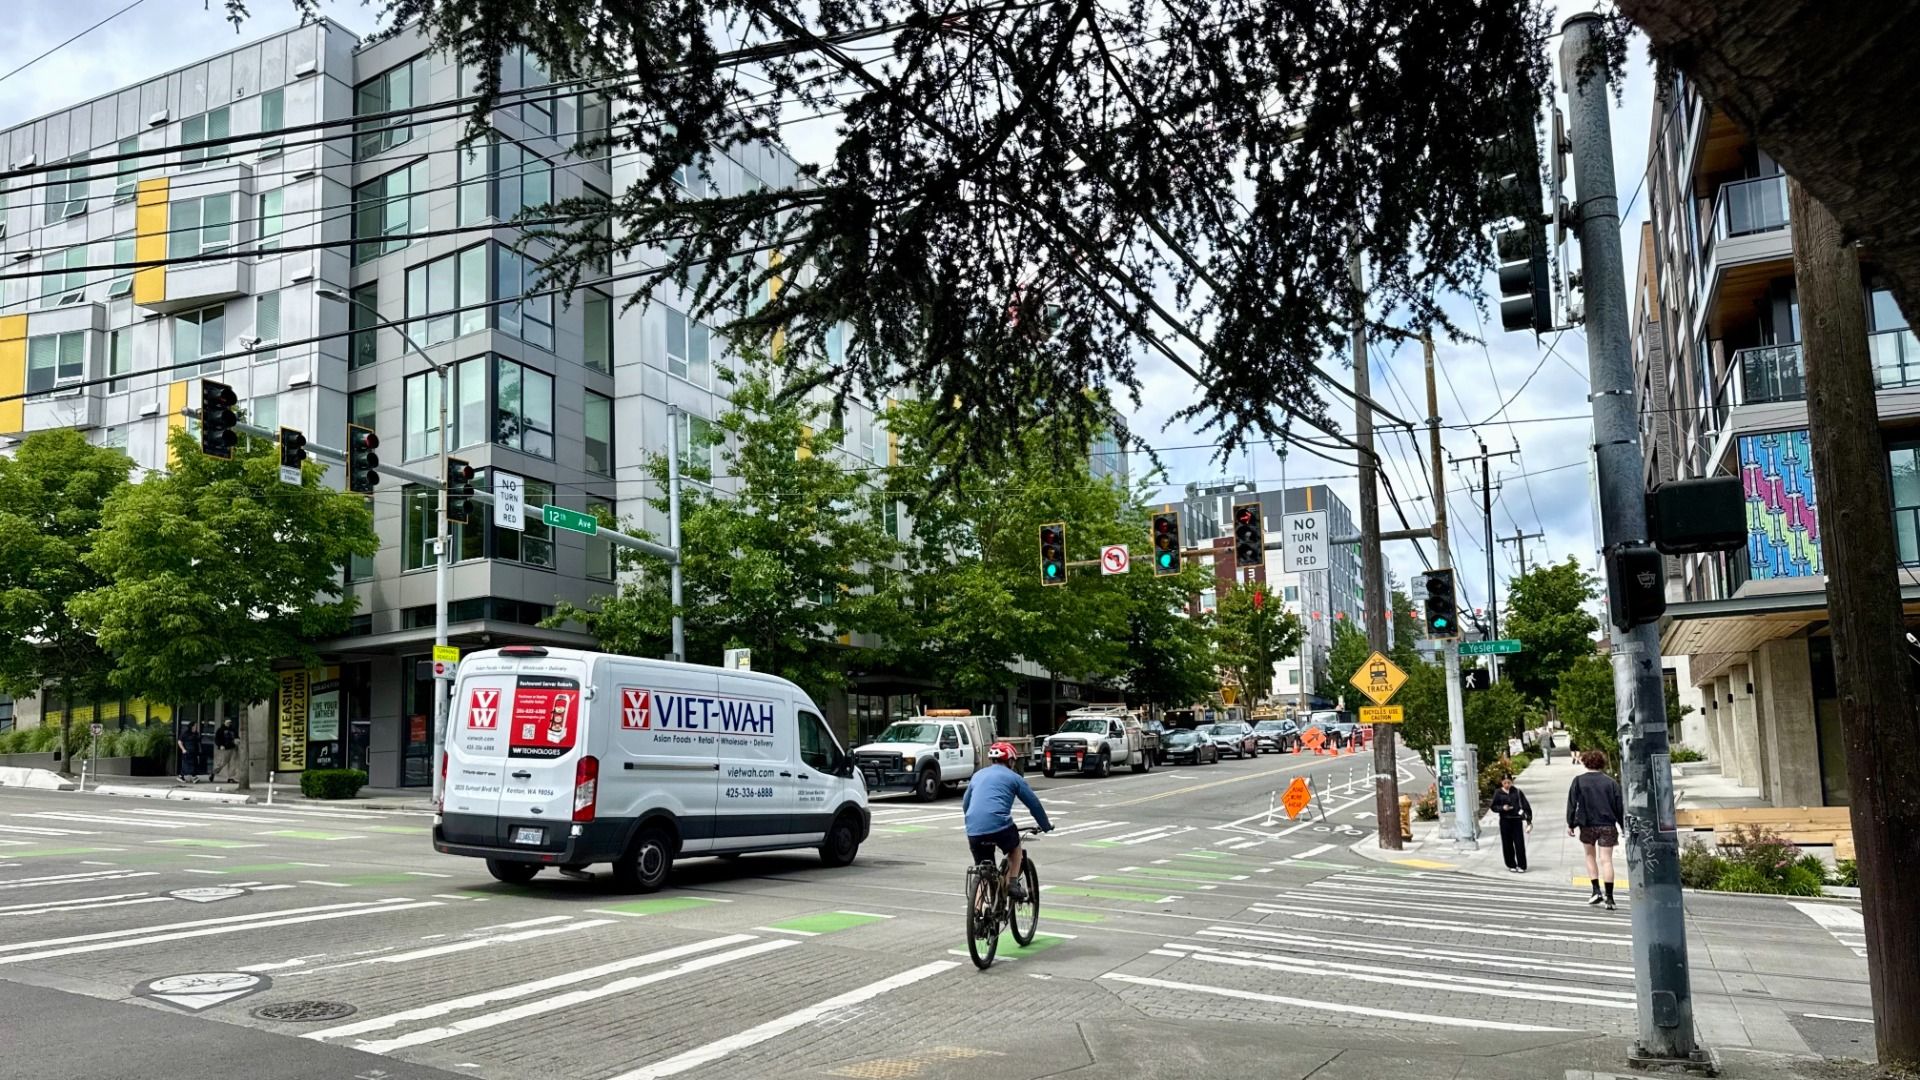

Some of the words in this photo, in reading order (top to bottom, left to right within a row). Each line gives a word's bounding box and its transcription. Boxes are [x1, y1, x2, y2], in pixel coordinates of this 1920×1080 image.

[502, 479, 517, 491] NO
[500, 491, 518, 502] TURN
[504, 503, 515, 512] ON
[503, 513, 517, 523] RED
[549, 510, 567, 522] 12th
[578, 518, 591, 529] Ave
[1294, 518, 1315, 530] NO
[1291, 531, 1318, 542] TURN
[1298, 544, 1312, 553] ON
[1296, 556, 1317, 566] RED
[1469, 643, 1496, 653] Yesler
[1367, 684, 1394, 692] TRACKS
[282, 676, 293, 730] LEASING
[292, 672, 305, 767] ANTHEM12.COM
[654, 695, 774, 733] VIET-WAH
[653, 734, 672, 743] Asian
[672, 735, 691, 744] Foods
[698, 735, 715, 745] Retail
[720, 737, 748, 747] Wholesale
[753, 738, 774, 748] Delivery
[281, 733, 292, 762] NOW
[727, 767, 775, 778] vietwah.com
[725, 787, 774, 798] 425-336-6888
